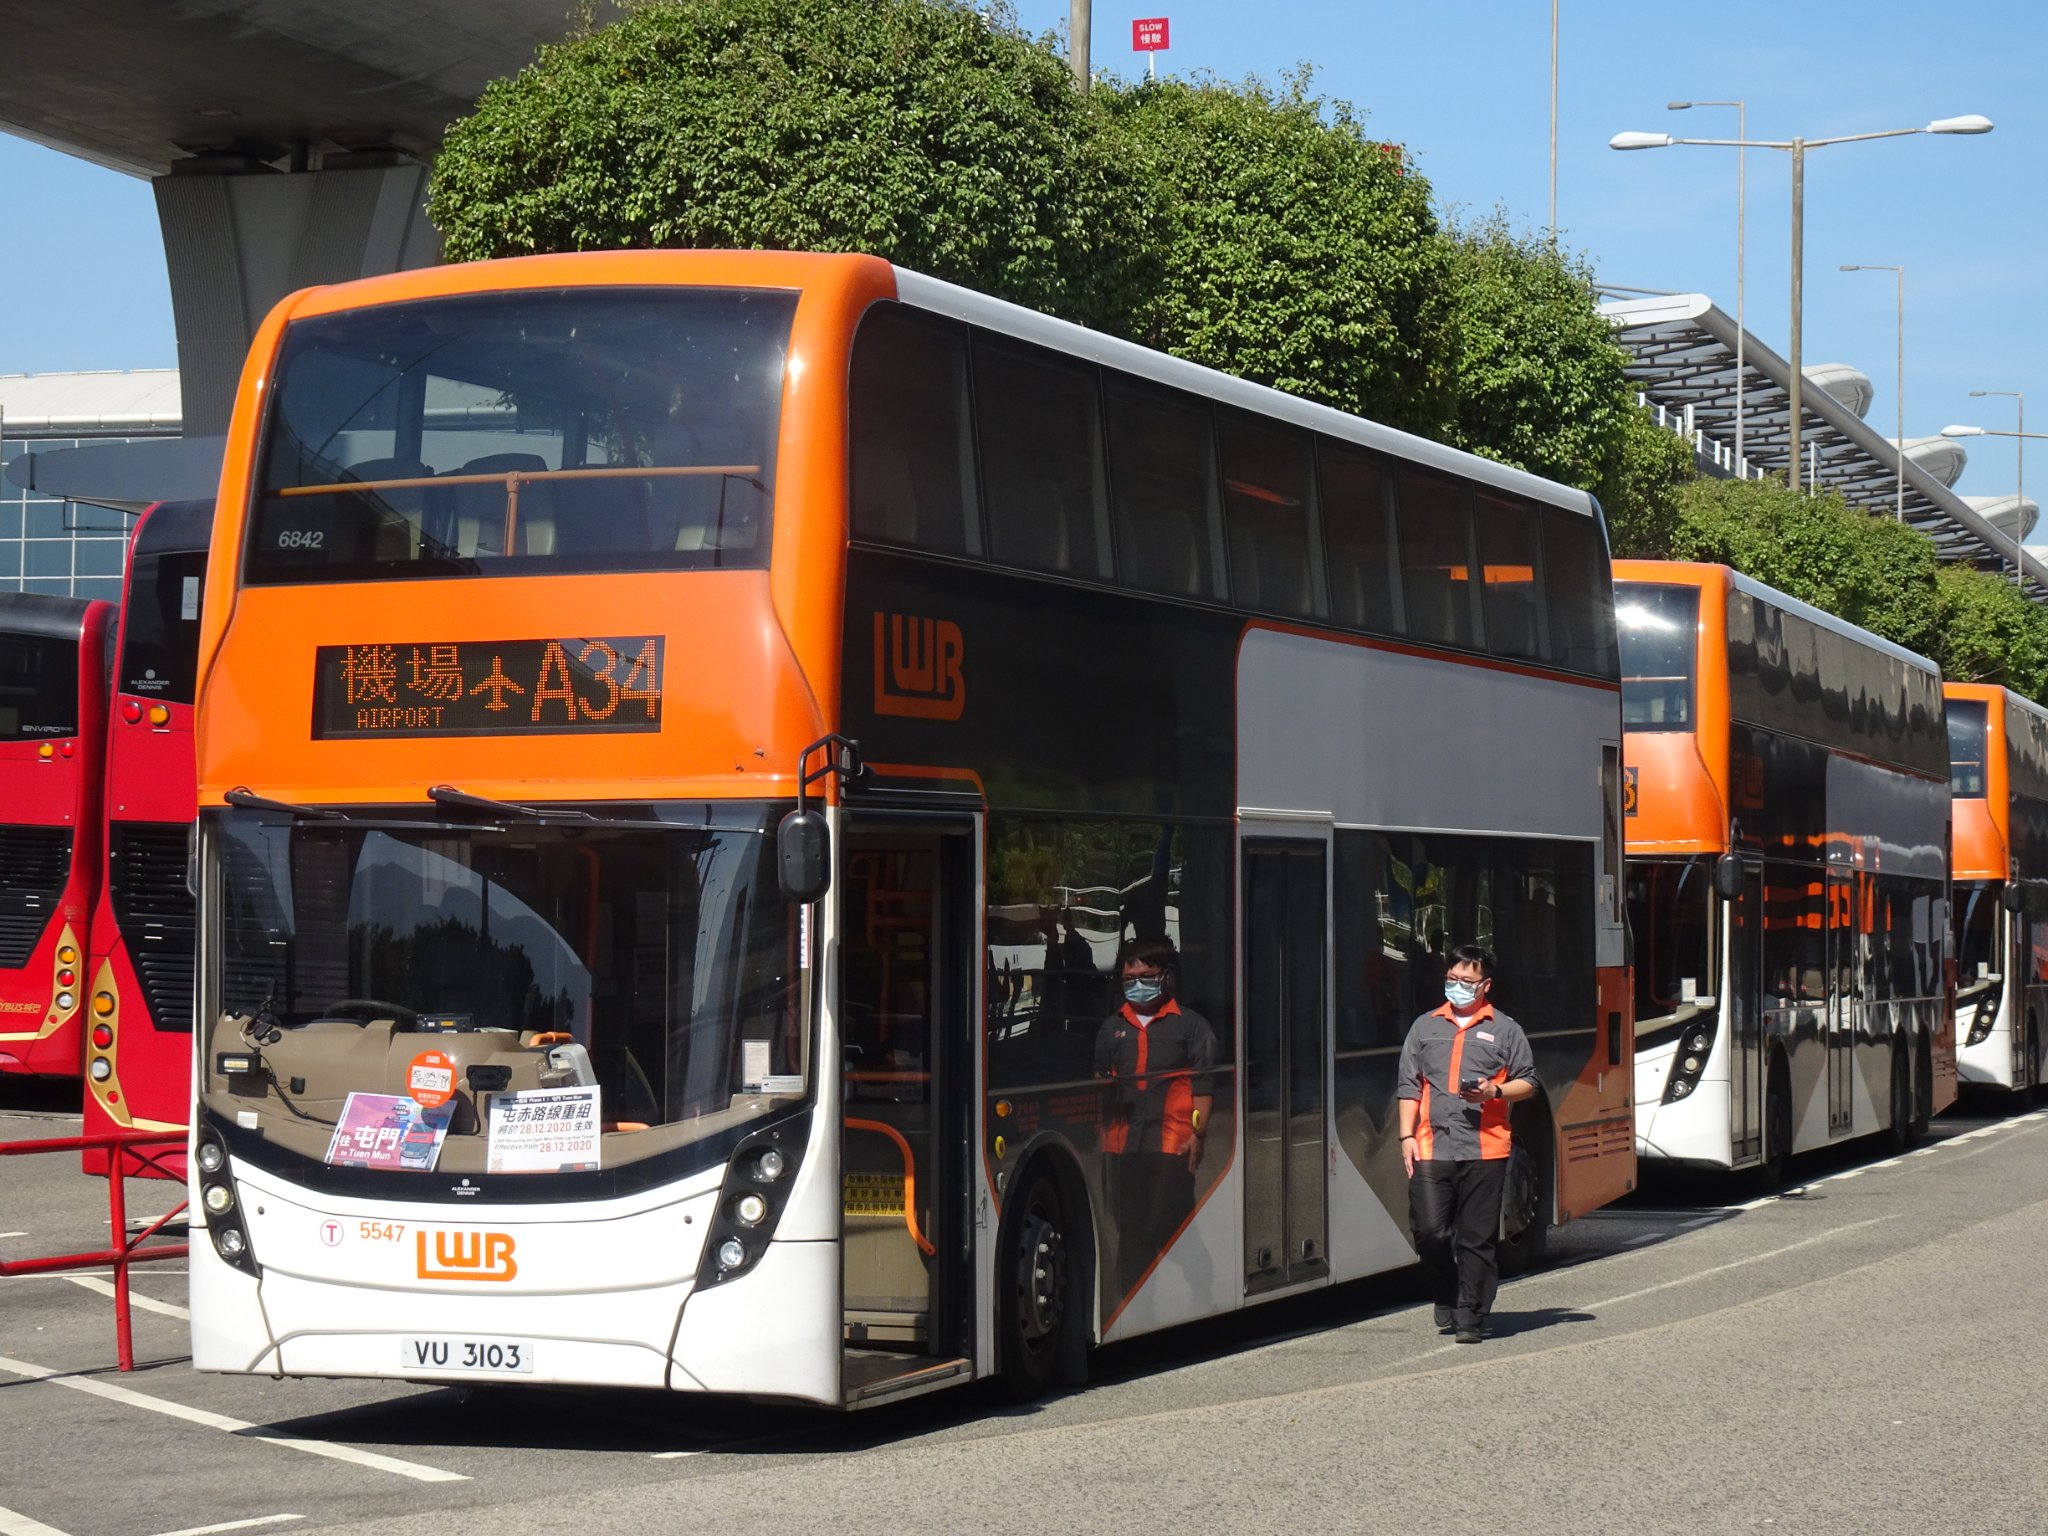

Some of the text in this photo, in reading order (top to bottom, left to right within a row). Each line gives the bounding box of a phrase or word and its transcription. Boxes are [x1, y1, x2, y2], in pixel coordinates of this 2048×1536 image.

[1139, 23, 1162, 32] SLOW
[279, 530, 324, 548] 6842
[340, 645, 463, 704] 機場
[874, 611, 966, 720] LWB
[531, 639, 662, 722] A34
[357, 706, 445, 729] AIRPORT
[502, 1103, 592, 1123] 屯赤路線重組
[354, 1125, 401, 1150] 屯門
[519, 1121, 572, 1134] 28.12.2020
[349, 1148, 371, 1158] Tuen
[371, 1150, 391, 1160] Mun
[539, 1140, 592, 1153] 28.12.2020
[360, 1221, 405, 1243] 5547
[416, 1230, 518, 1282] LWB
[415, 1340, 521, 1369] VU 3103
